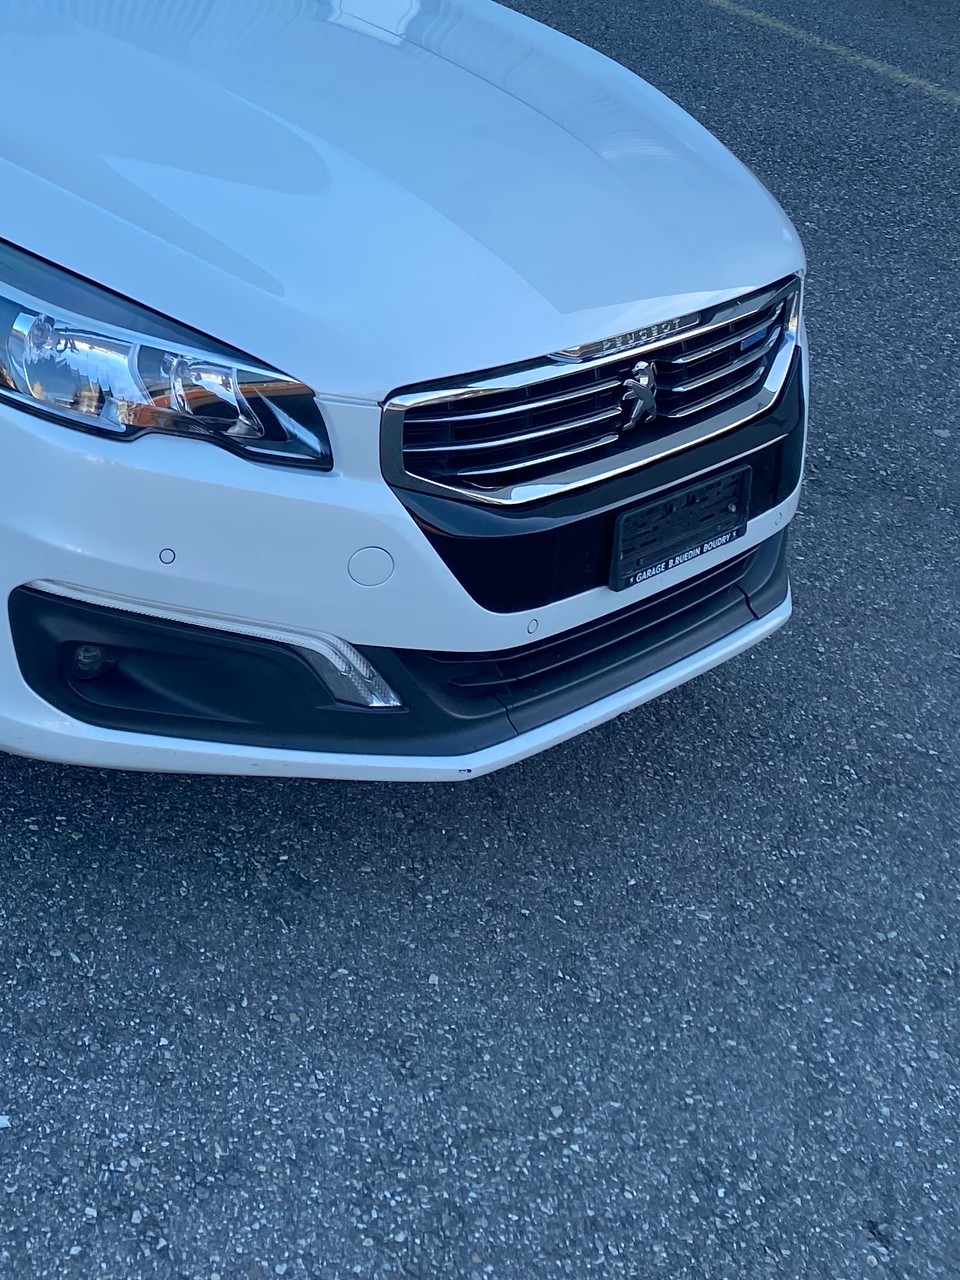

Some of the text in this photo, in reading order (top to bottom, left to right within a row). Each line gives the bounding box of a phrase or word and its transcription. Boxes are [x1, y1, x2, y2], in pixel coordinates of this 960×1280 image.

[602, 318, 680, 351] PEUGEOT
[636, 532, 731, 582] GARAGE B.RUEDIN BOUDRY
